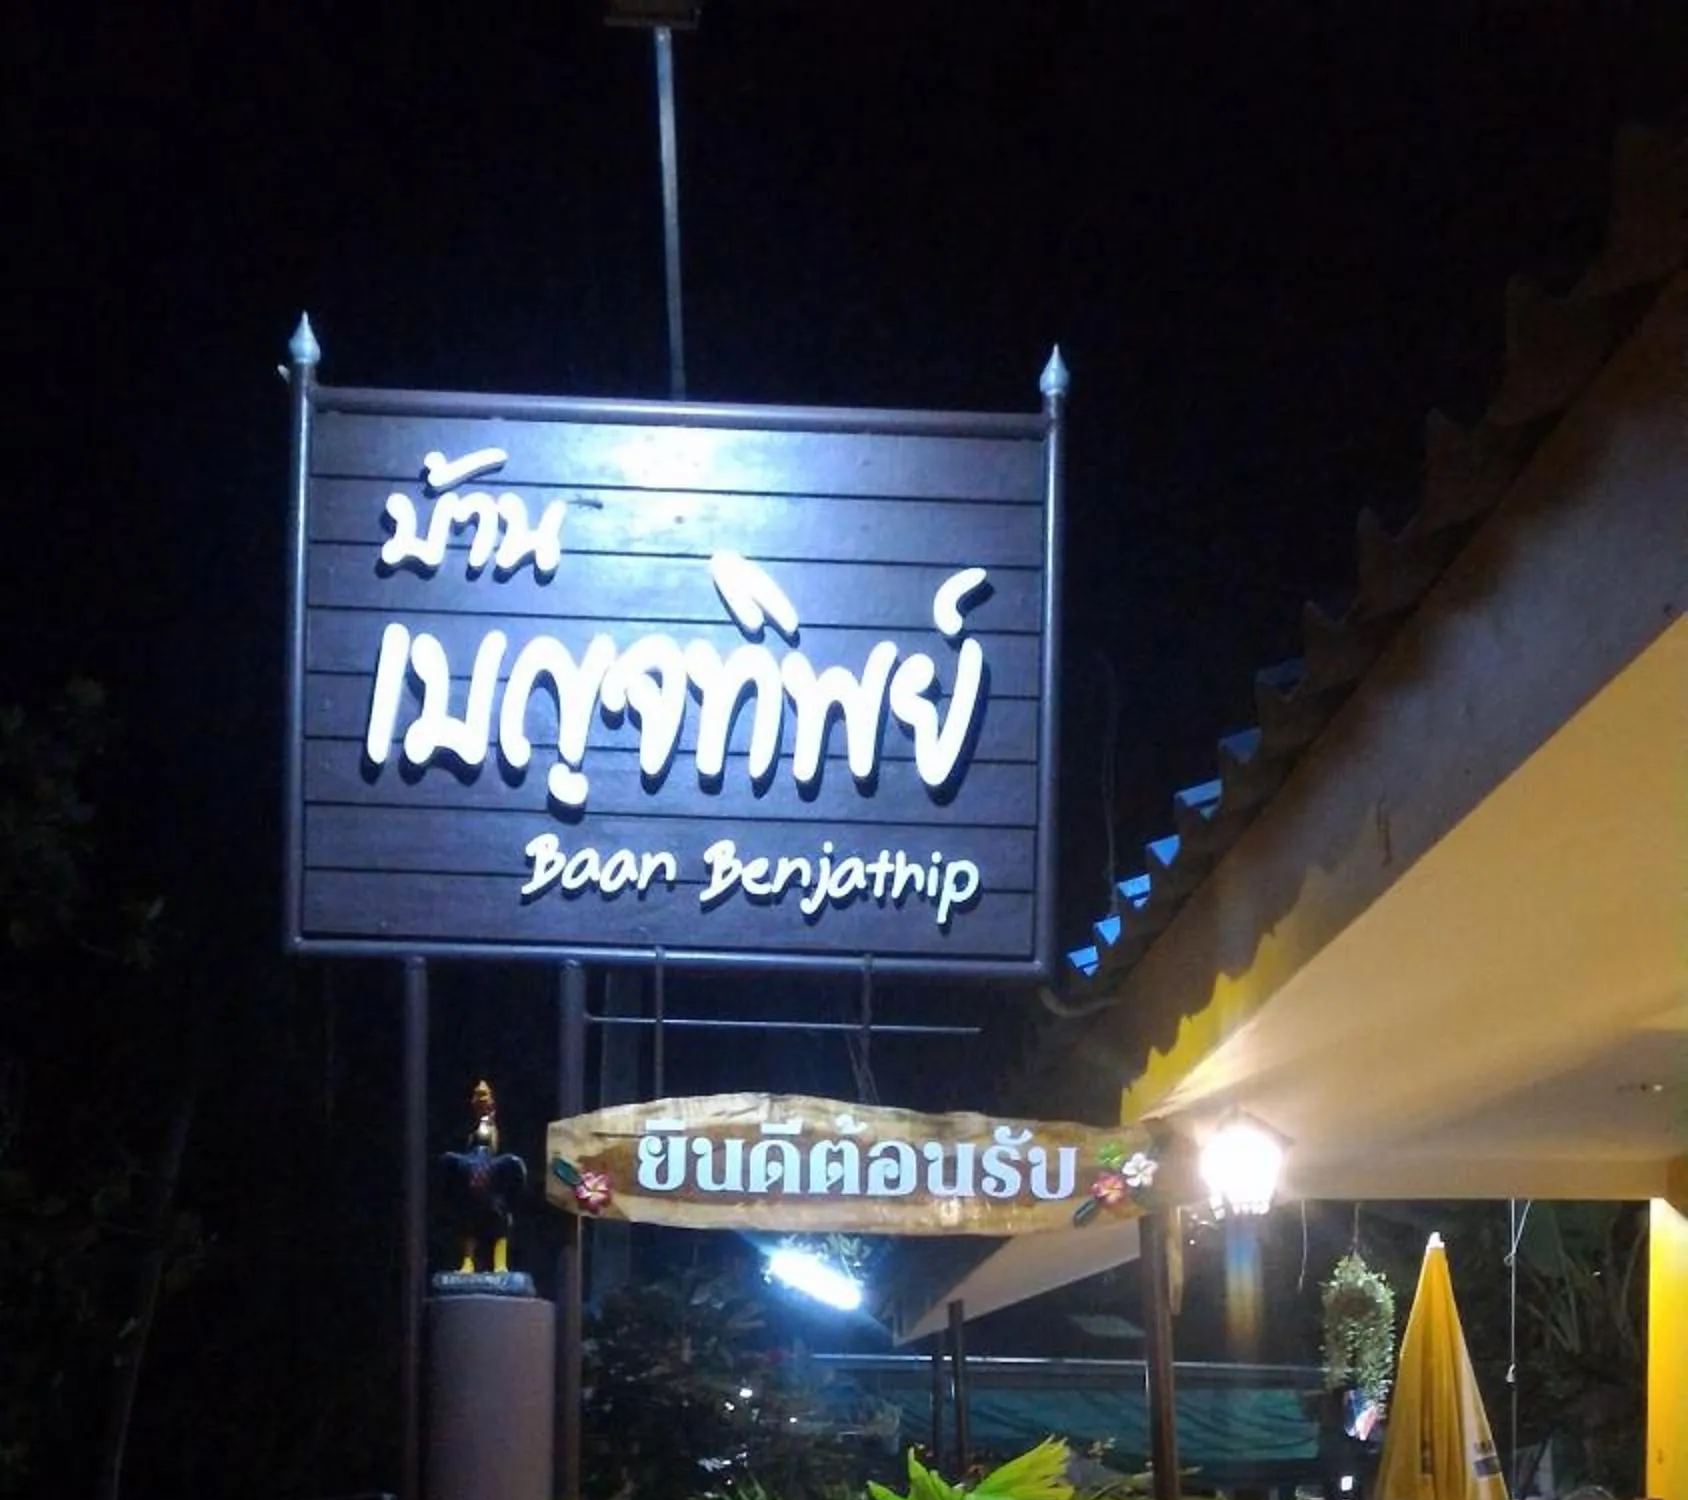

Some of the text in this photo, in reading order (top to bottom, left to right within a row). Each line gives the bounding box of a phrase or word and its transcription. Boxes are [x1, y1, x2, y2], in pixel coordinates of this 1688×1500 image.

[381, 447, 567, 572] บ้าน
[521, 833, 980, 924] Baan Benjathip
[637, 1113, 1079, 1200] ยินดีต้อนรับ
